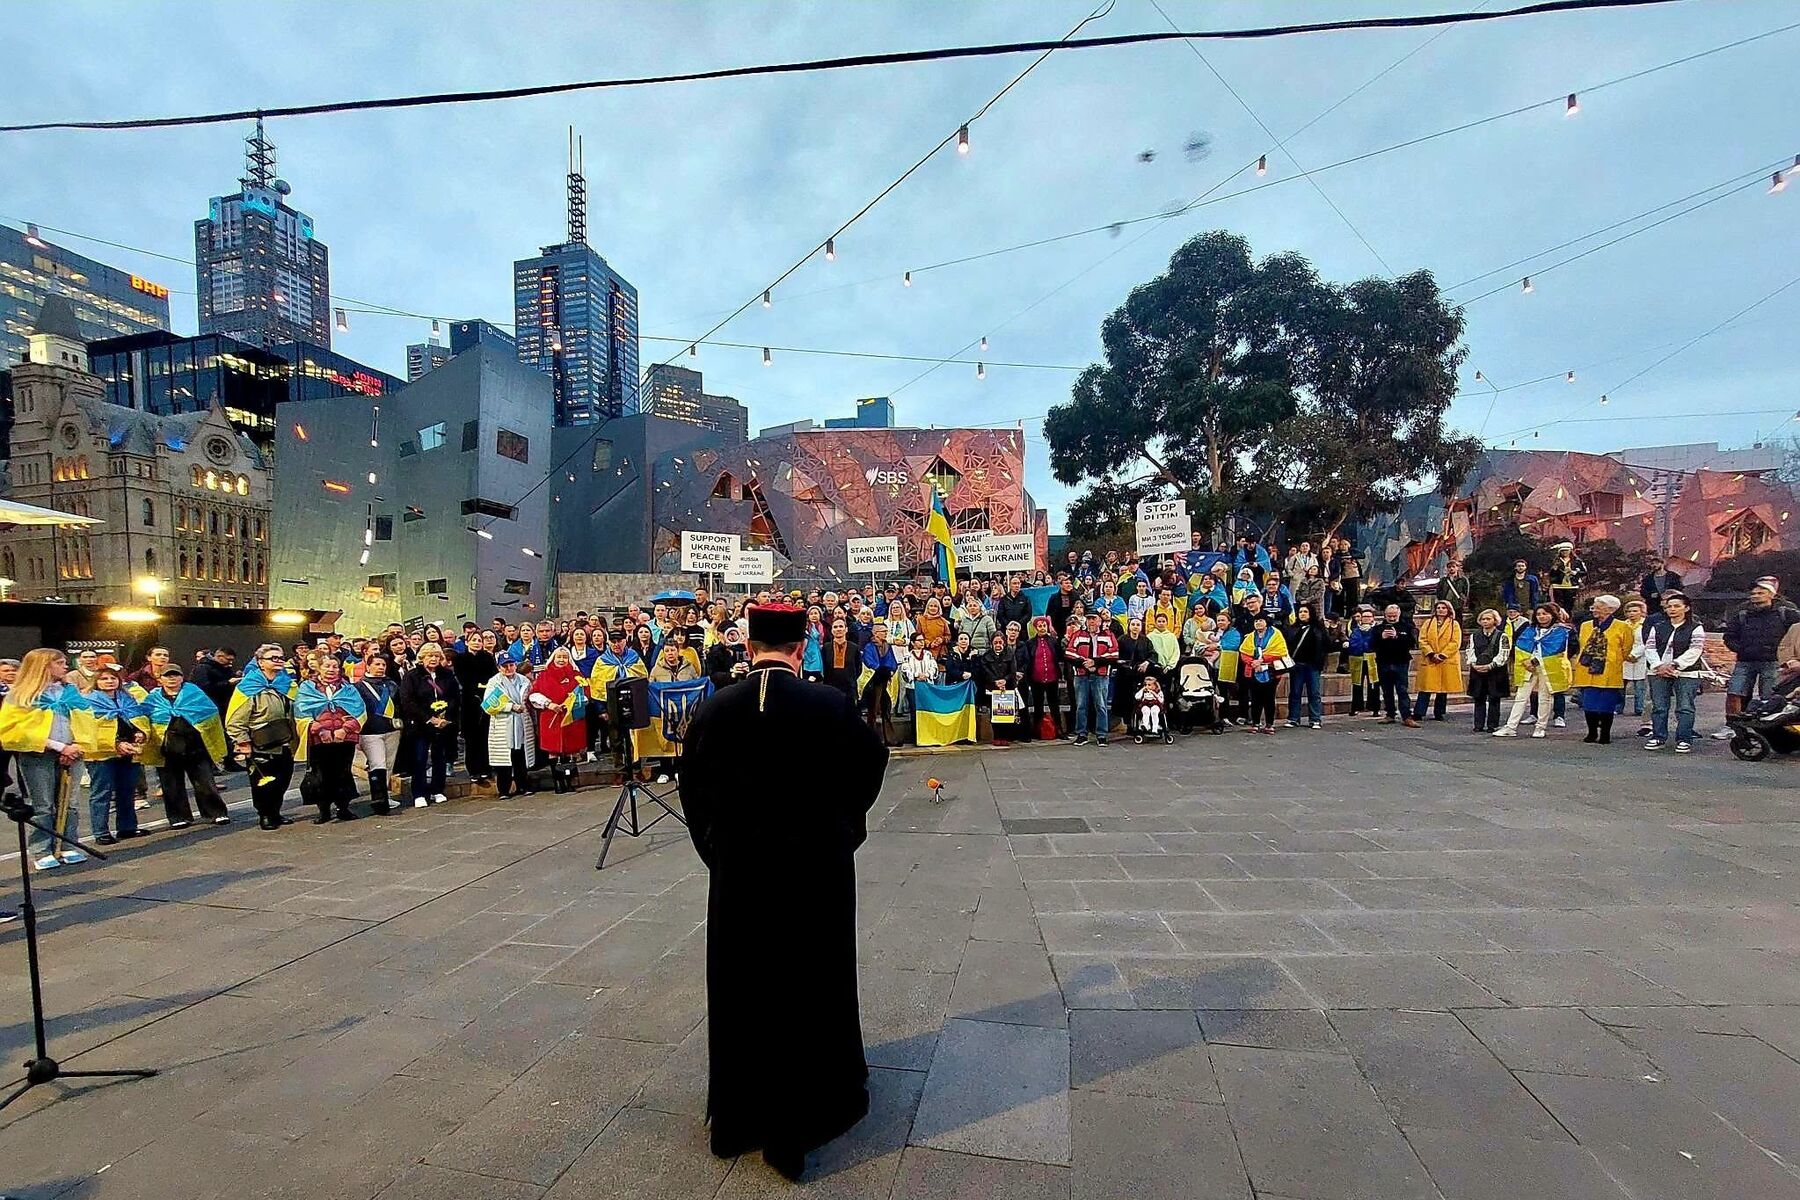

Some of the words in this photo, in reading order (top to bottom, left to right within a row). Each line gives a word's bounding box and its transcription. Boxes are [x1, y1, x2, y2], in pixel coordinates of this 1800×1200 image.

[131, 275, 168, 298] BHP
[878, 471, 908, 484] SBS
[1145, 503, 1176, 513] STOP
[690, 534, 732, 543] SUPPORT
[691, 544, 730, 552] UKRAINE
[962, 545, 981, 553] WILL
[985, 544, 1011, 552] STAND
[853, 555, 892, 564] UKRAINE
[989, 552, 1029, 562] UKRAINE
[692, 561, 729, 570] EUROPE
